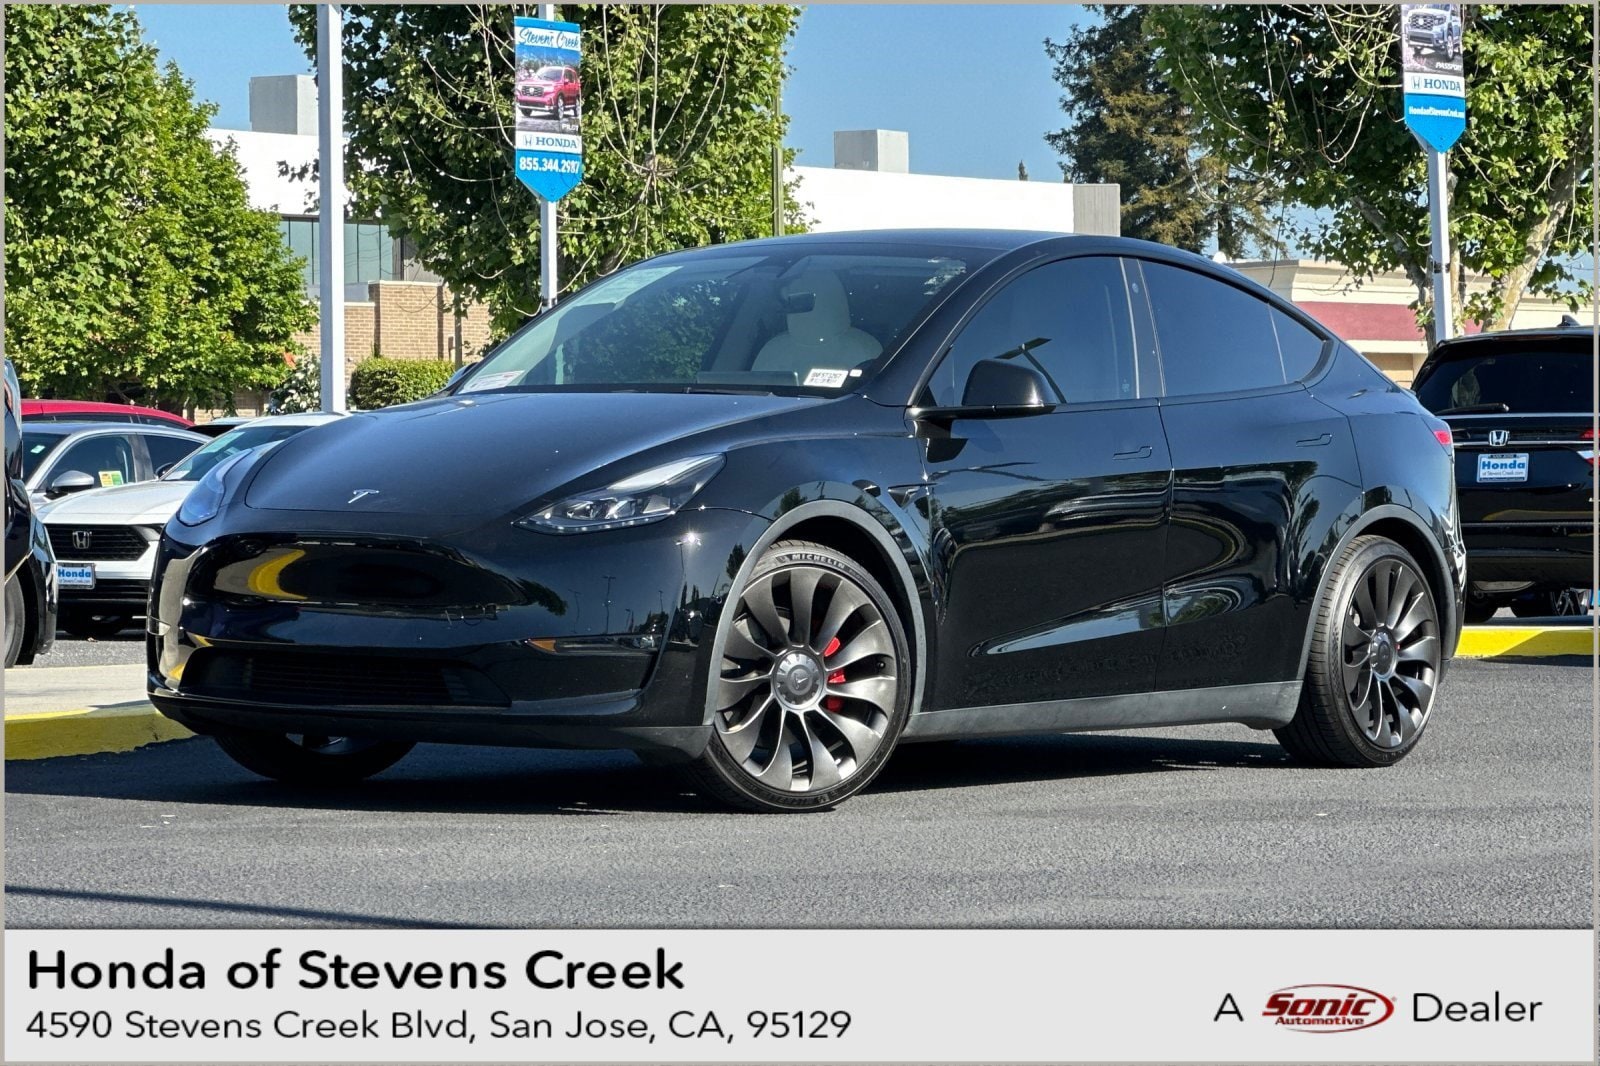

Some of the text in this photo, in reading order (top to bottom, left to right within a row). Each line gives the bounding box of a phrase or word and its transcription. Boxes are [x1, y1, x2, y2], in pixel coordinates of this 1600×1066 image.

[519, 27, 579, 49] Stevens Creek
[1424, 79, 1461, 91] HONDA
[535, 136, 577, 148] HONDA
[1482, 460, 1525, 469] Honda
[792, 554, 844, 568] MICHELIN
[58, 569, 91, 577] Honda
